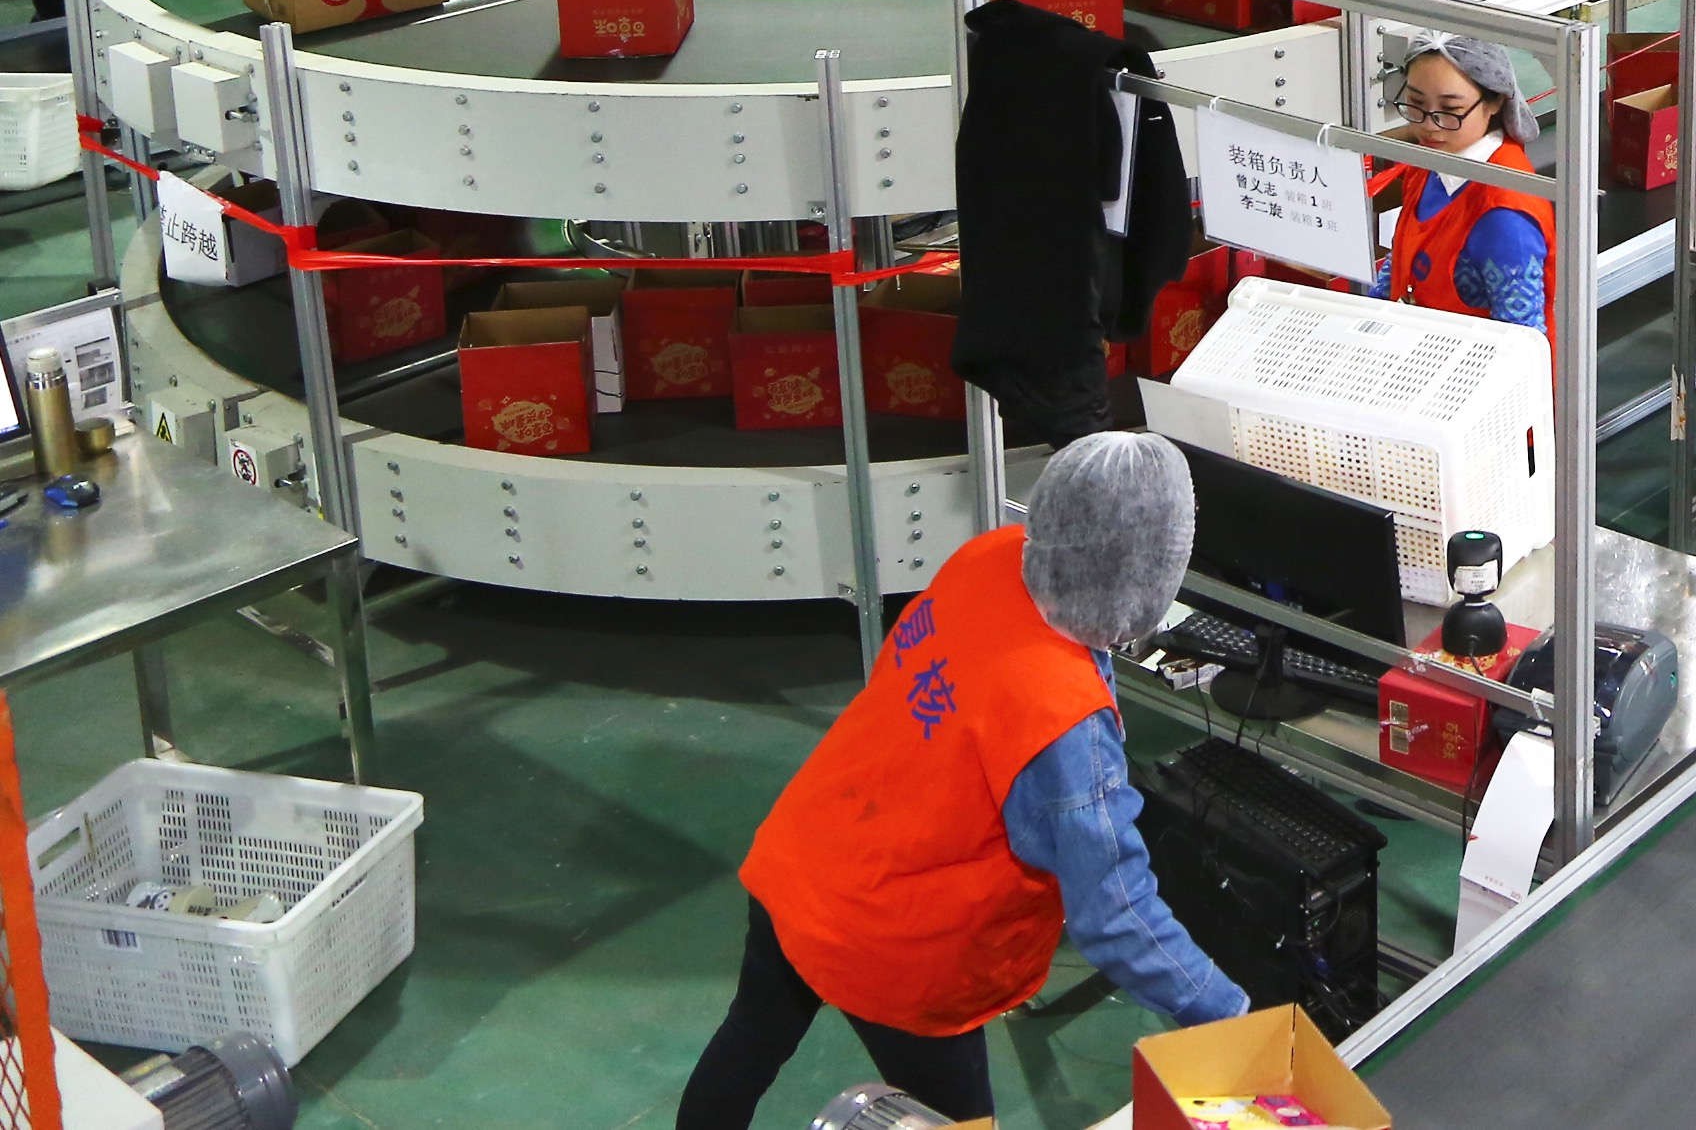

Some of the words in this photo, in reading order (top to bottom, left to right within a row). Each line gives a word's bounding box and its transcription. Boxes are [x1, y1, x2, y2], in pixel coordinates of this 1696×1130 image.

[1228, 143, 1328, 188] 装箱负责人
[893, 598, 957, 740] 复核
